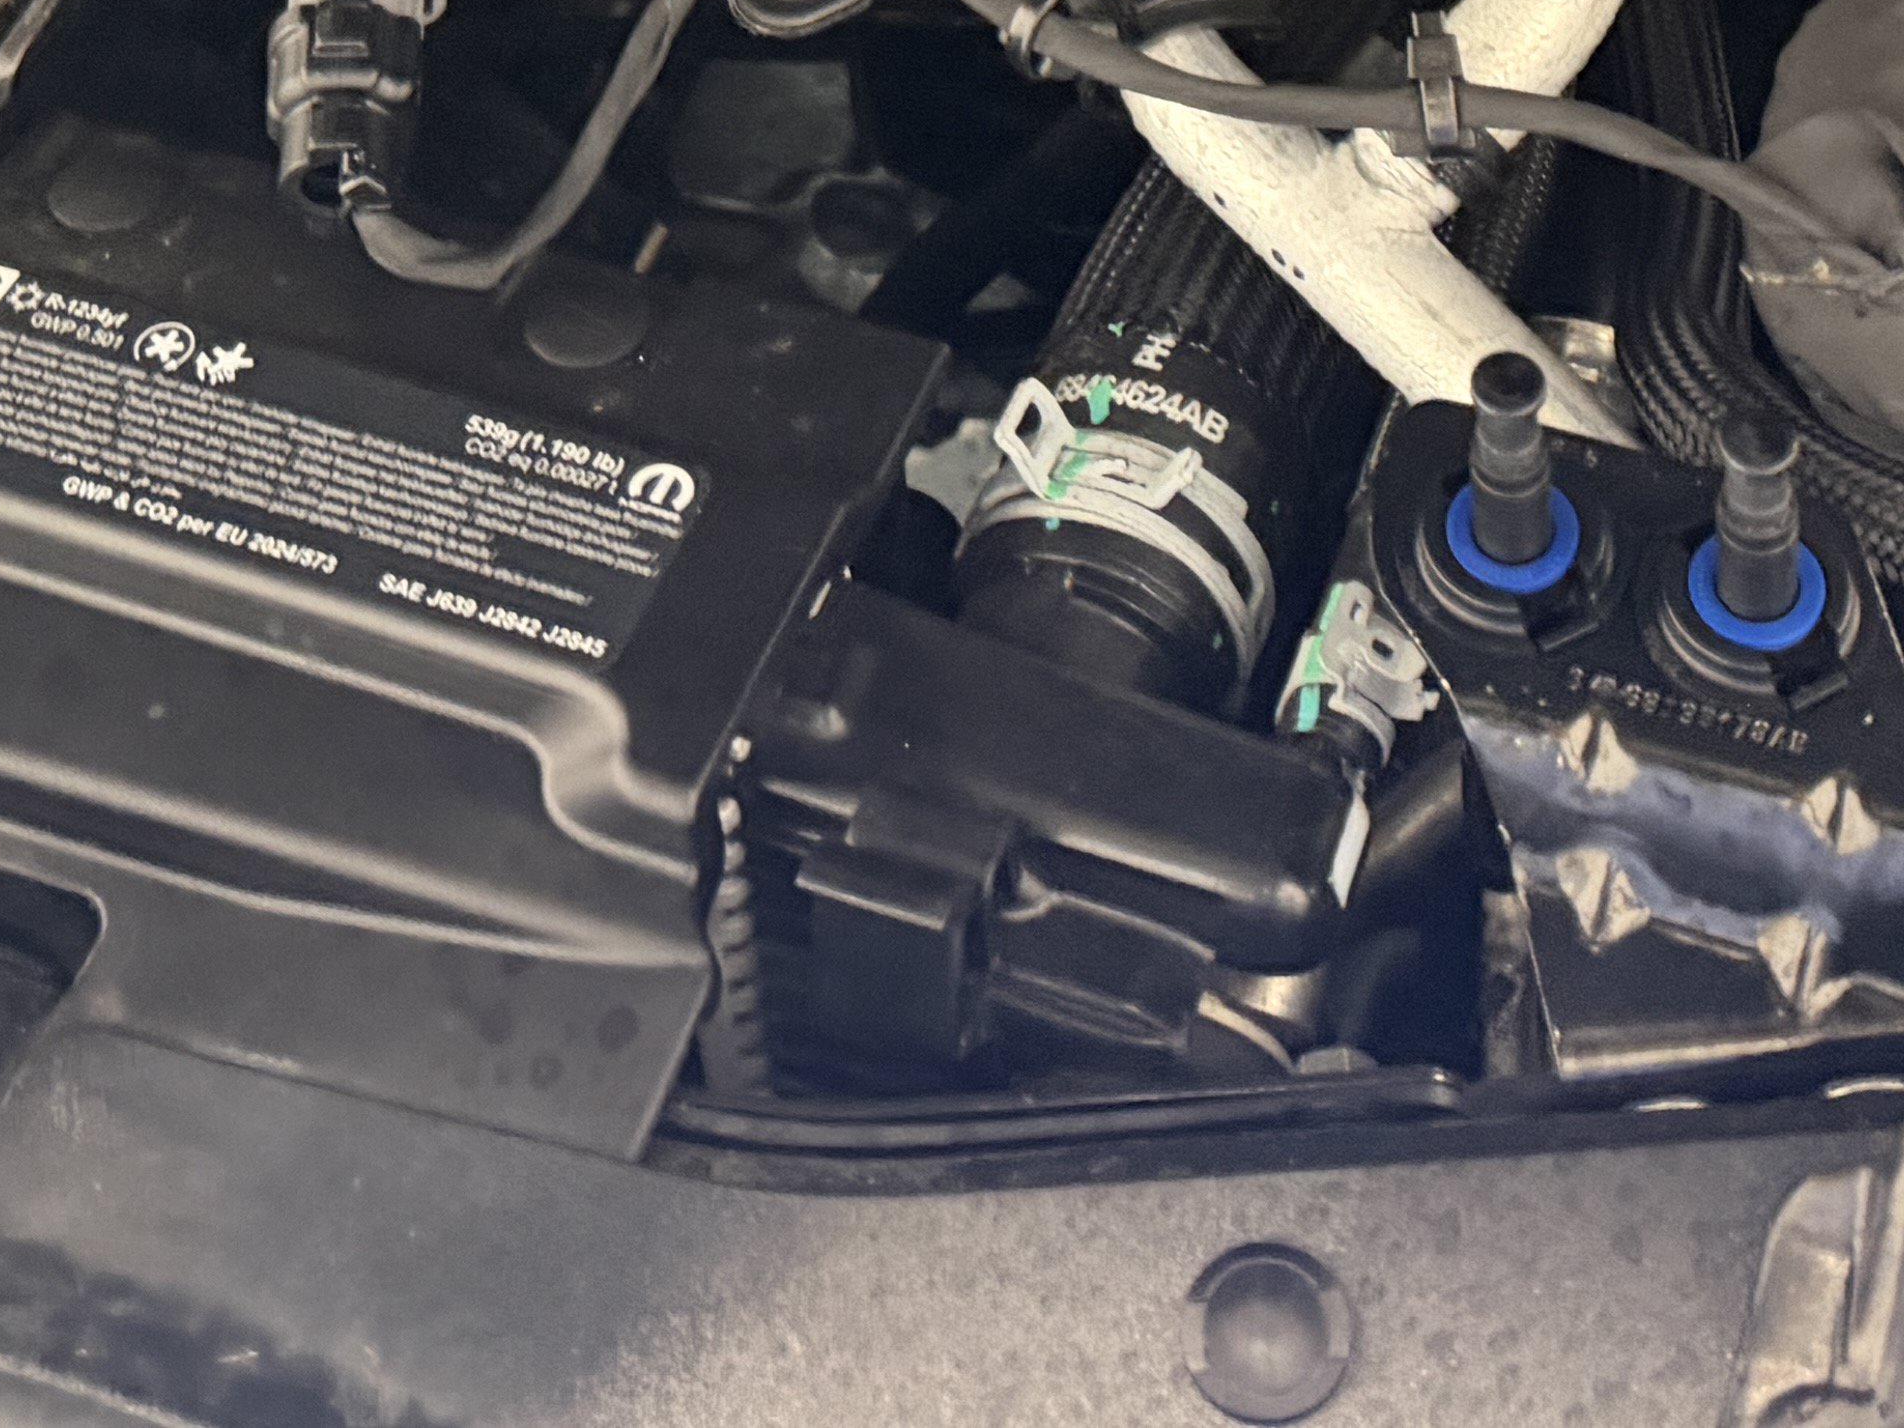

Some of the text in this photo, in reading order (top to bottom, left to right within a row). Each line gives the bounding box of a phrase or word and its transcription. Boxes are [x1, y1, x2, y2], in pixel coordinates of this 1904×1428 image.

[62, 475, 113, 504] GWP
[133, 497, 179, 525] CO2
[176, 514, 215, 537] per
[214, 521, 249, 546] EU
[379, 573, 427, 603] SAE
[426, 588, 478, 619] J639
